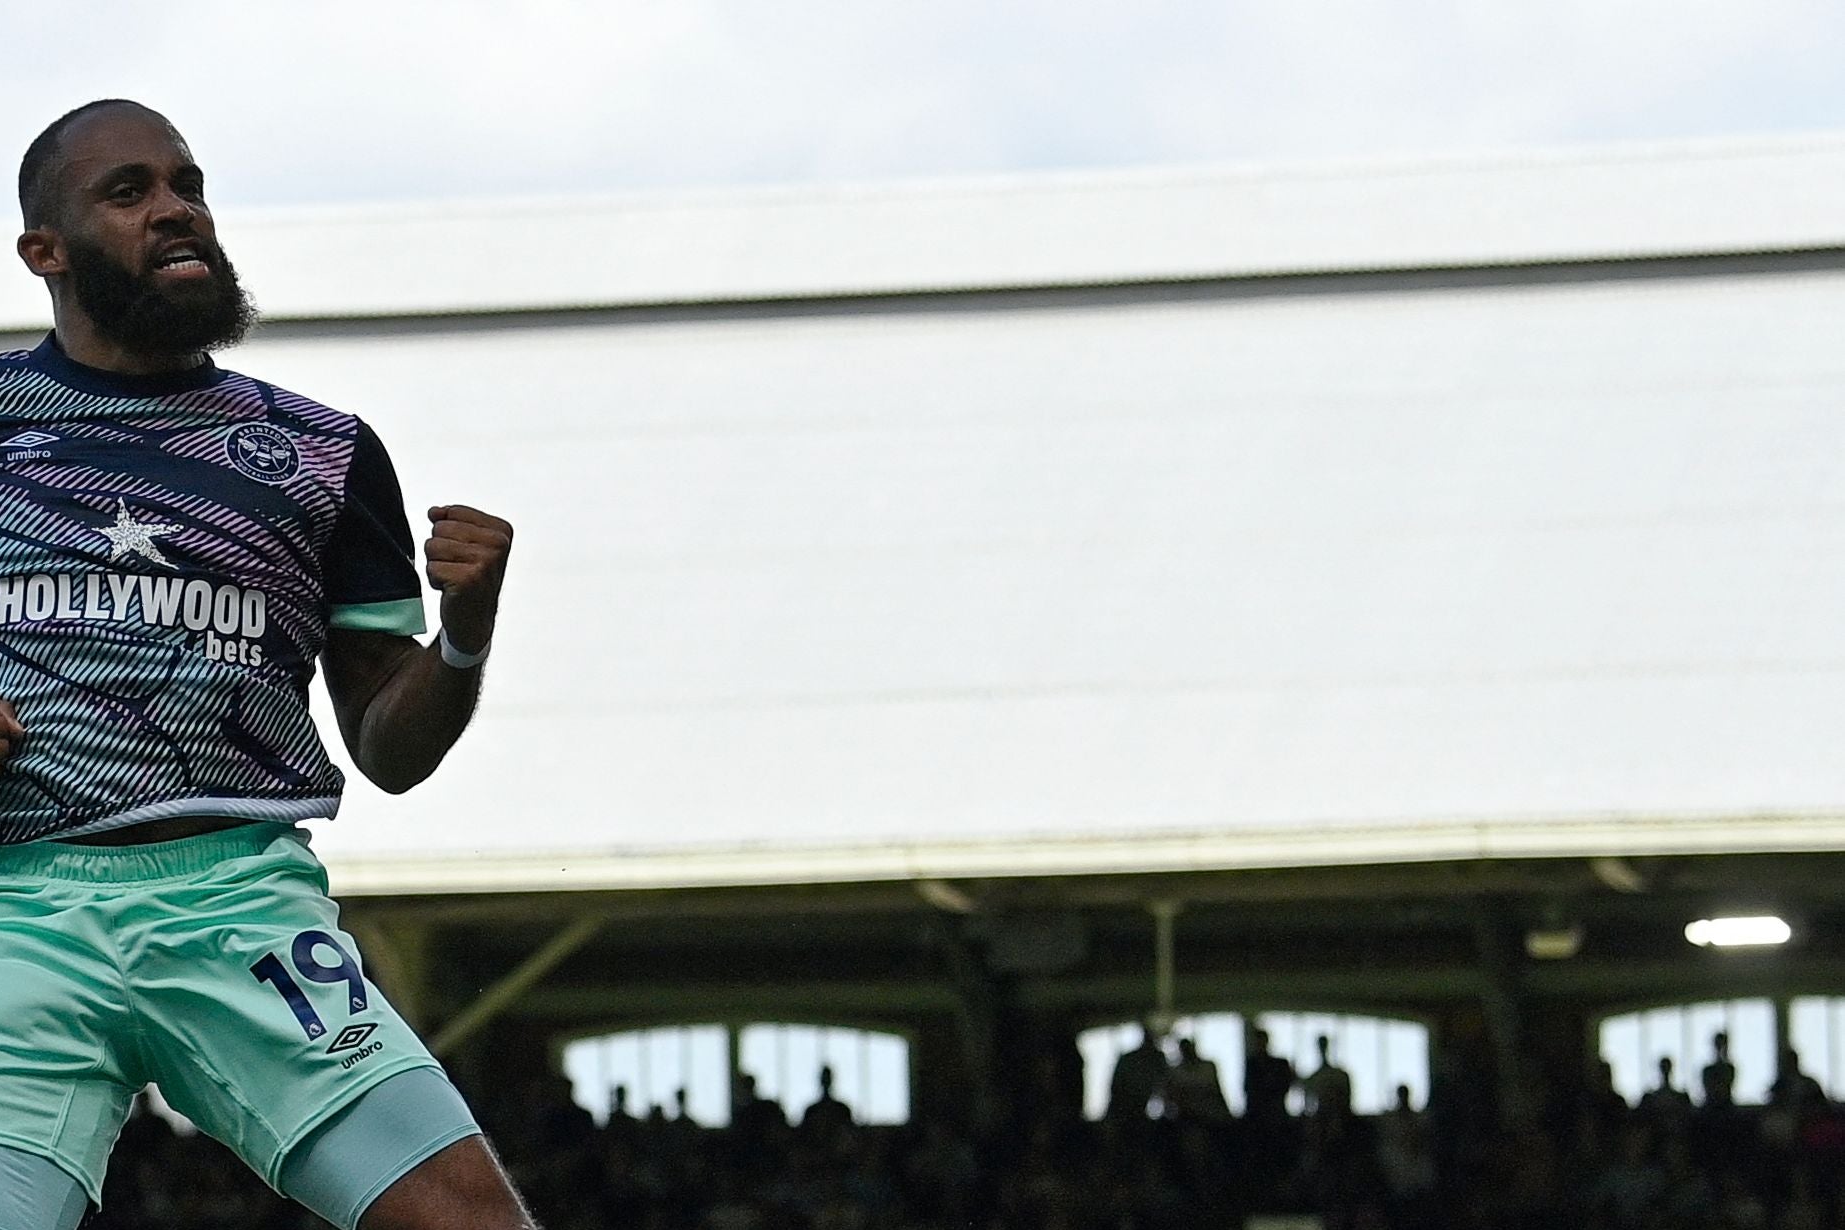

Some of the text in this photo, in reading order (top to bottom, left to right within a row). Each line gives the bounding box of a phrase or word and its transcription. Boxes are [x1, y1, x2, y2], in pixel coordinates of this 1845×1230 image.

[6, 448, 52, 462] umbro
[206, 630, 263, 667] bets
[249, 930, 368, 1042] 19
[341, 1041, 384, 1070] umbro
